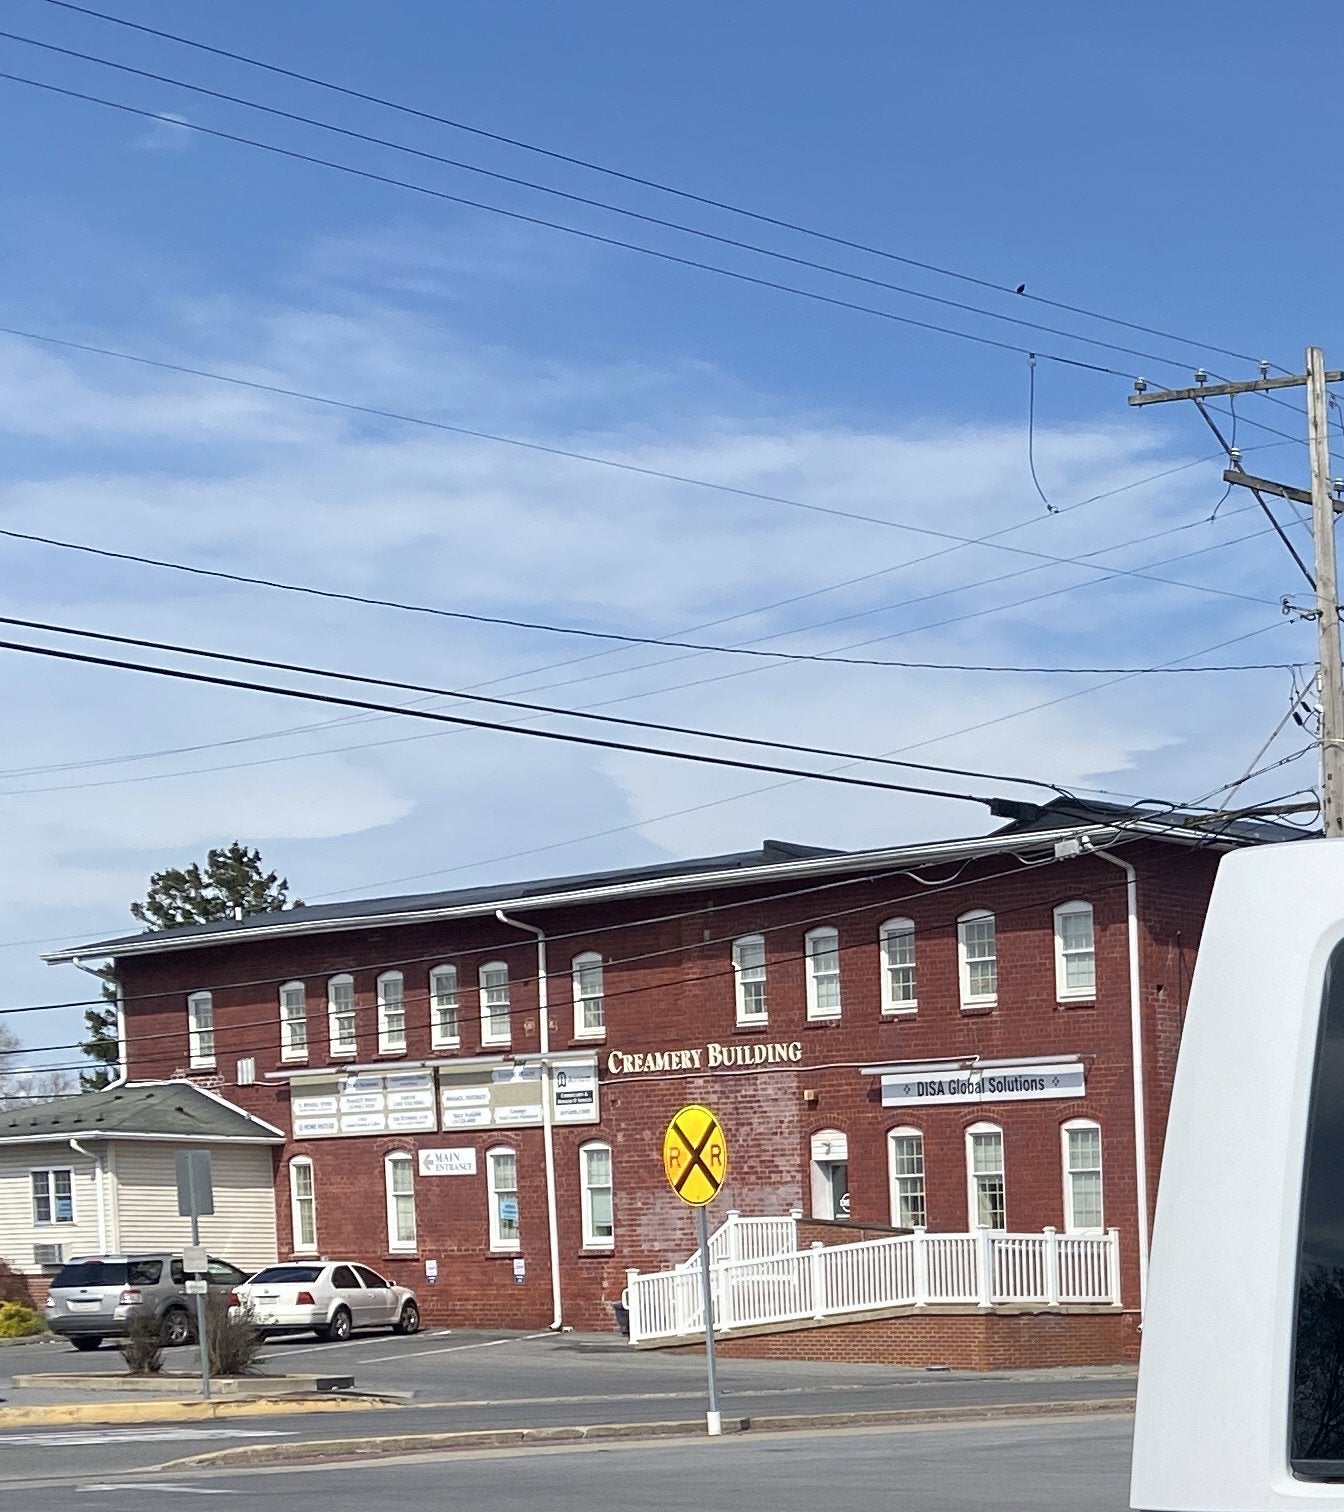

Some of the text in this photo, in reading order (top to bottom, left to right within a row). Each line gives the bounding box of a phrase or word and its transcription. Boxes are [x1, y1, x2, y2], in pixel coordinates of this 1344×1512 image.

[917, 1075, 1045, 1097] DISA Global Solutions
[434, 1152, 460, 1163] MAIN
[435, 1163, 472, 1171] ENTRANCE
